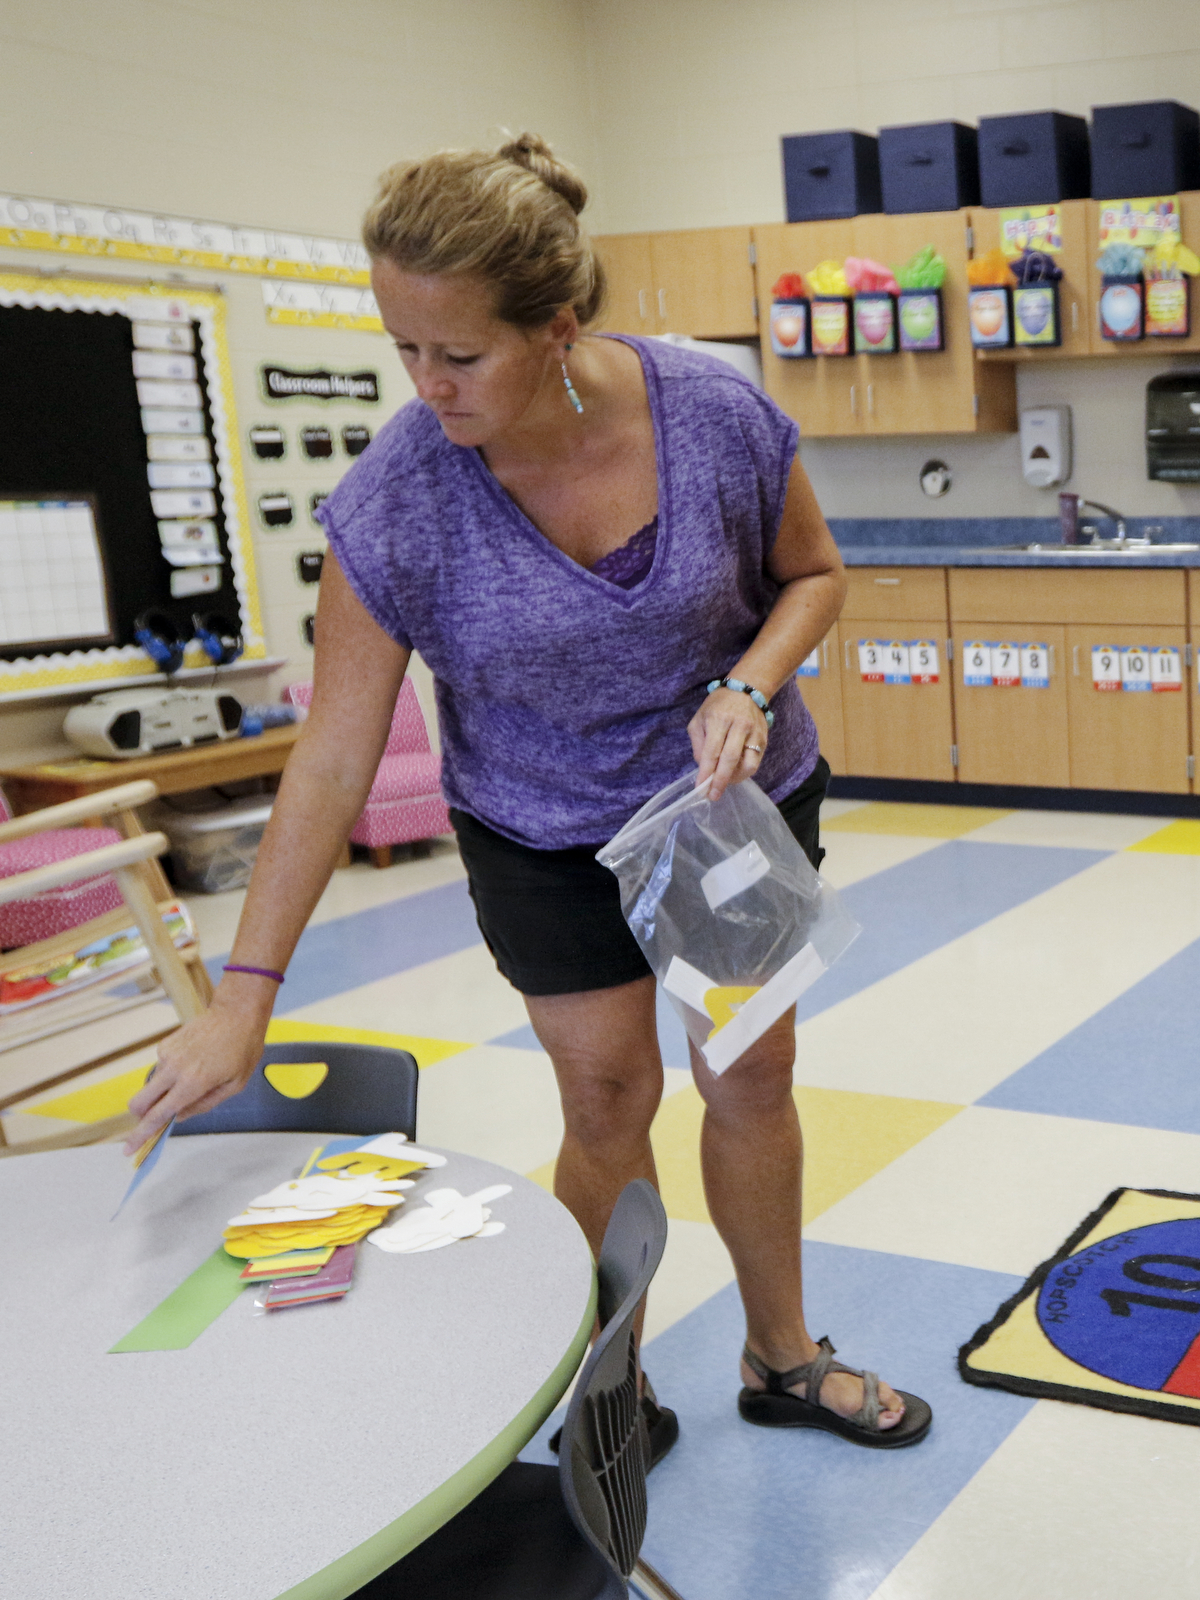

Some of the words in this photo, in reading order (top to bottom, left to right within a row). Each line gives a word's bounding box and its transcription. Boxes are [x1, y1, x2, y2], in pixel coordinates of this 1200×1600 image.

[1101, 209, 1179, 232] Birthday
[268, 371, 329, 394] Classroom
[329, 374, 375, 398] Helpers
[867, 650, 876, 665] 3
[891, 650, 902, 665] 4
[919, 651, 929, 665] 5
[972, 652, 983, 667] 6
[1000, 652, 1010, 668] 7
[1030, 653, 1039, 668] 8
[1101, 656, 1111, 673] 9
[1128, 657, 1144, 673] 10
[1160, 657, 1172, 673] 11
[1045, 1235, 1139, 1324] HOPSCOTCH
